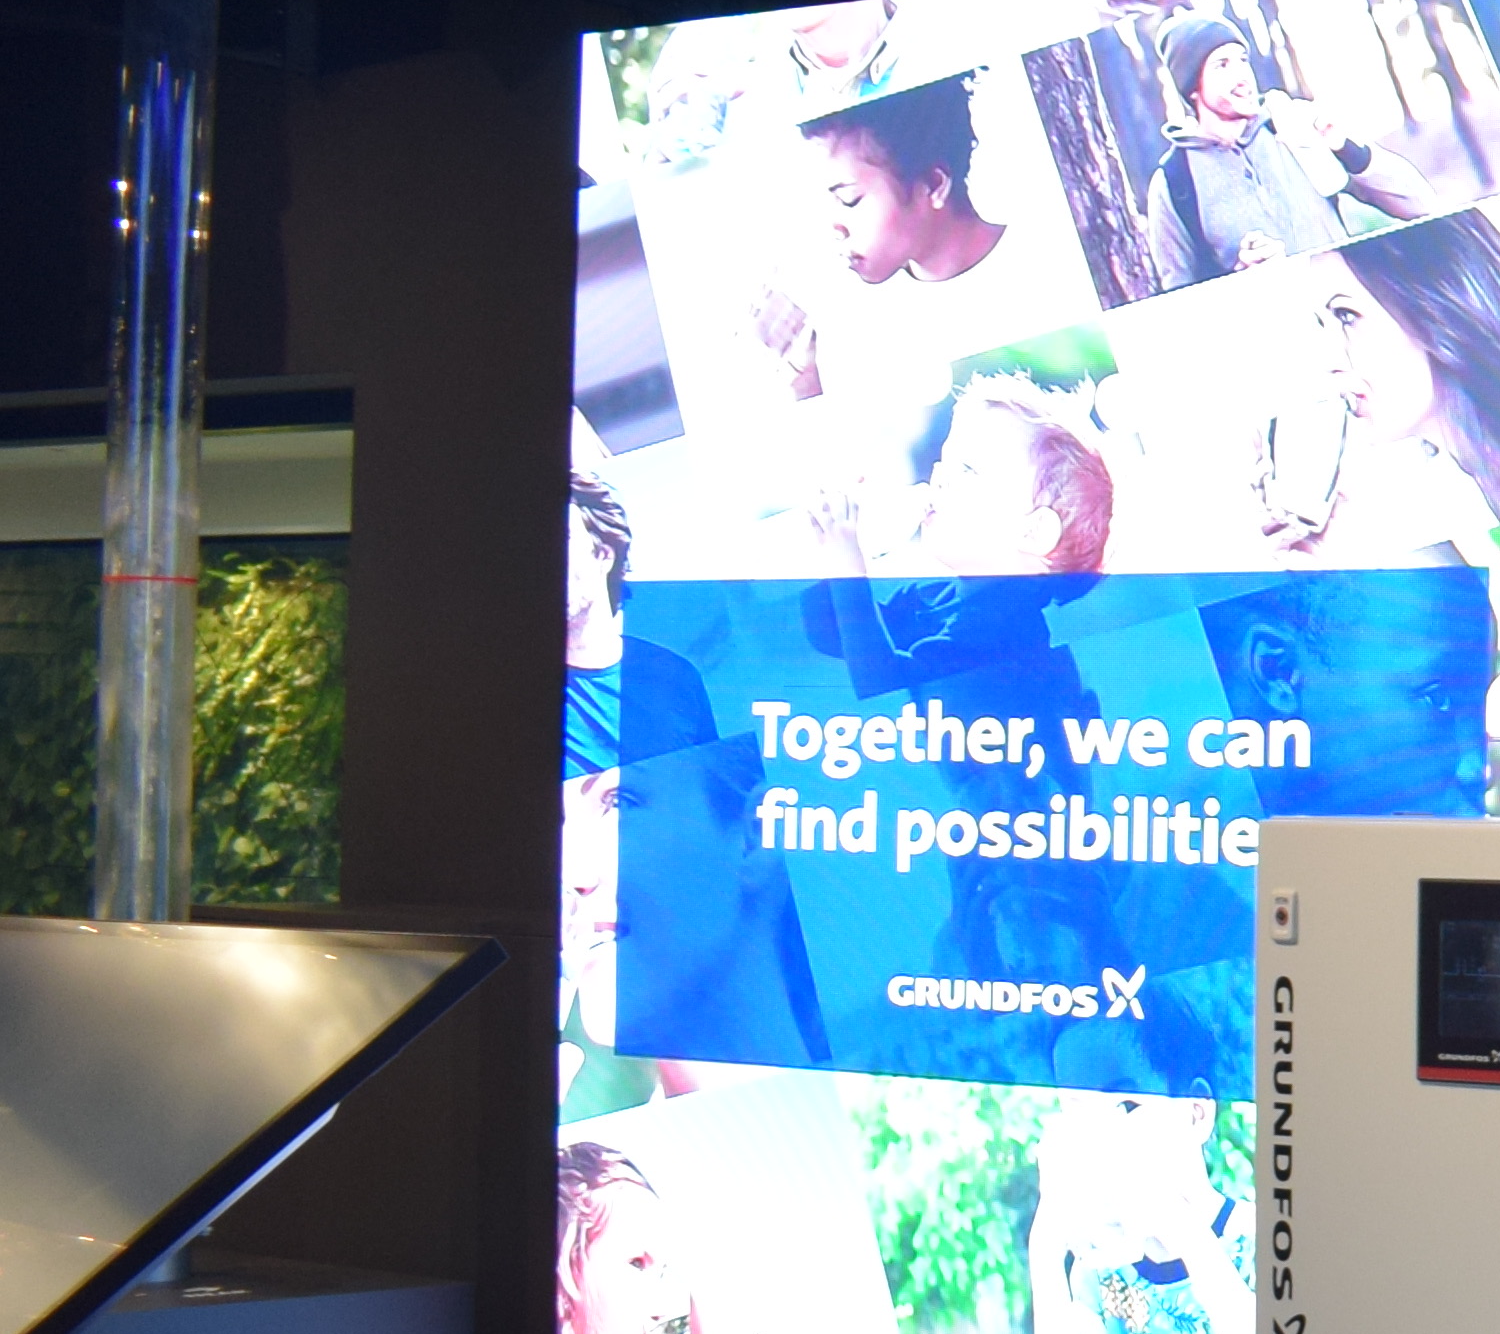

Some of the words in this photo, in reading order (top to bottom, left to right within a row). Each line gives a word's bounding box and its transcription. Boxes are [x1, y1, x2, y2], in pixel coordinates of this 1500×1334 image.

[752, 699, 1045, 779] Together,
[1065, 718, 1169, 768] we
[1187, 716, 1312, 769] can
[756, 788, 878, 854] find
[895, 793, 1260, 873] possibilitie
[887, 974, 1099, 1019] GRUNDFOS
[1272, 976, 1295, 1301] GRUNDFOS
